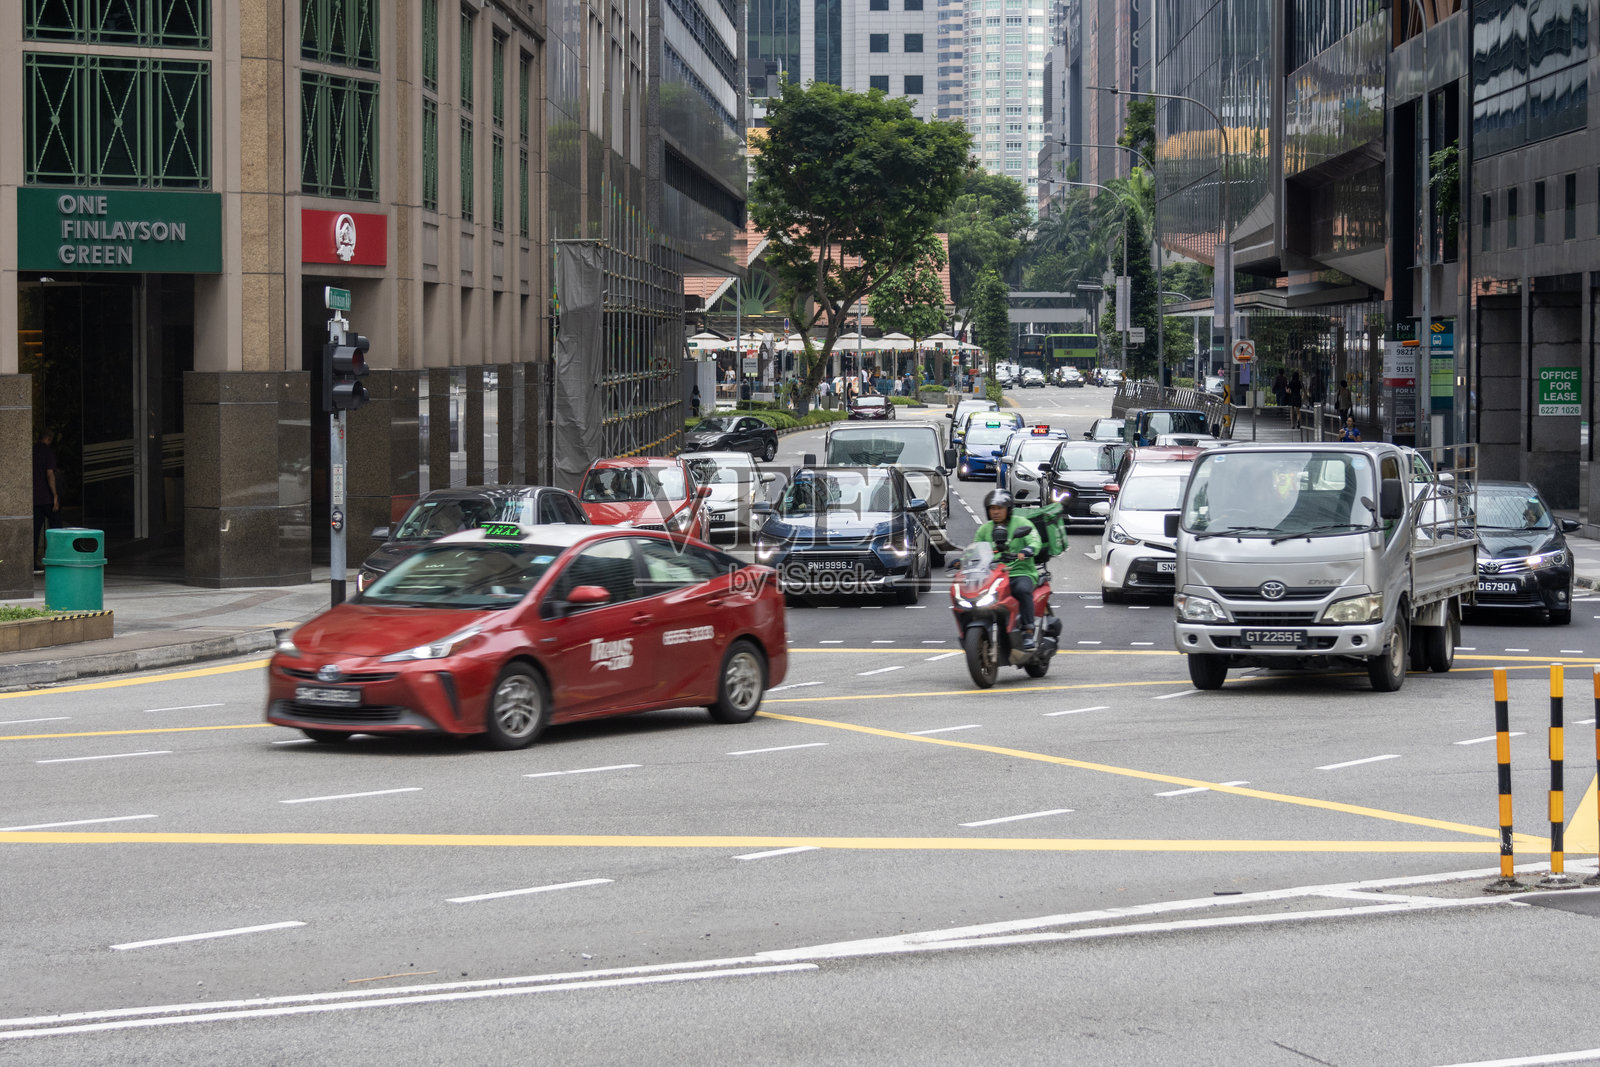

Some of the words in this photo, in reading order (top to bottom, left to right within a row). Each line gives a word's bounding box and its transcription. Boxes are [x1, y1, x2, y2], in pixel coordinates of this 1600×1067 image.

[57, 195, 107, 215] ONE
[60, 220, 186, 241] FINLAYSON
[58, 245, 133, 265] GREEN
[1396, 323, 1411, 331] For
[1540, 371, 1578, 380] OFFICE
[1550, 382, 1571, 391] FOR
[1544, 392, 1577, 401] LEASE
[1540, 406, 1559, 414] 6227
[1562, 406, 1579, 414] 1026
